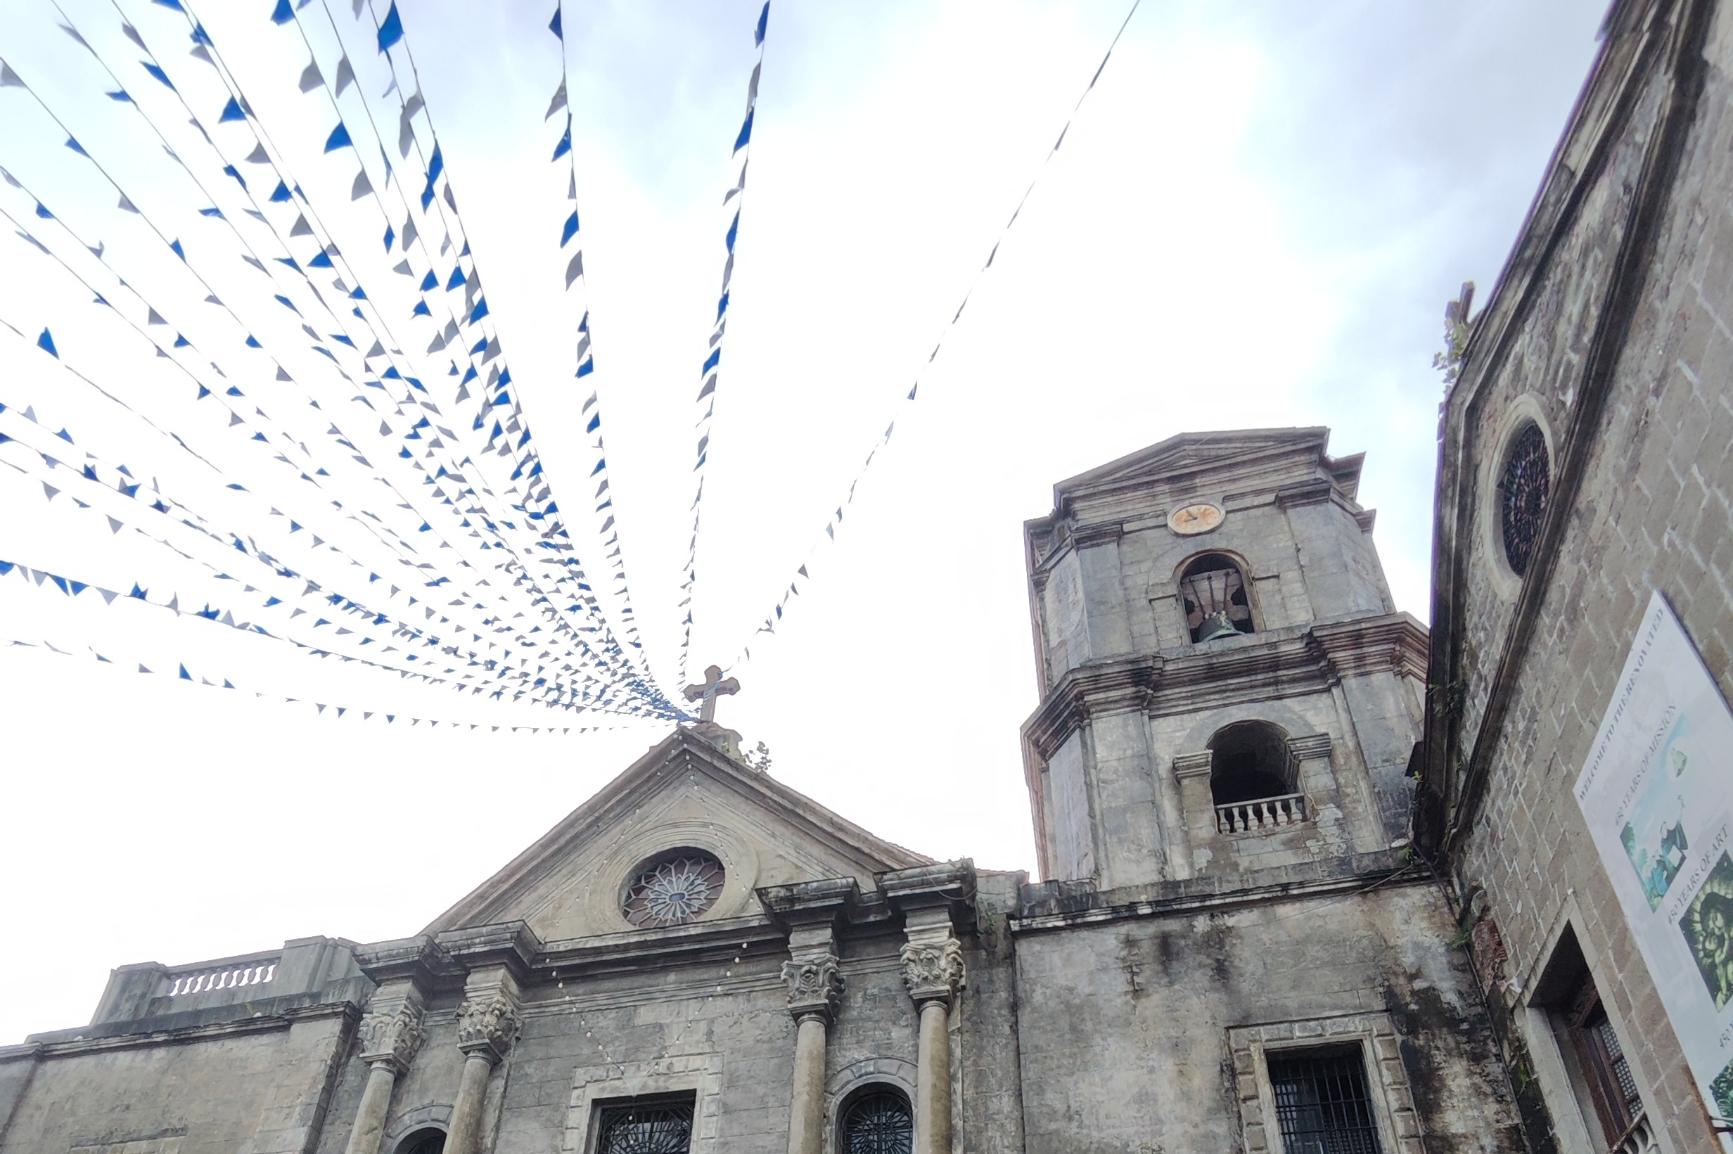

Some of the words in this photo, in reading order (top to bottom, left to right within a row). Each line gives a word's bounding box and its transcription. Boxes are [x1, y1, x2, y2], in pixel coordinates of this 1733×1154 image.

[1579, 741, 1607, 801] WELCOME
[1606, 724, 1615, 742] TO
[1614, 695, 1628, 723] THE
[1625, 608, 1664, 696] RENOVATED
[1622, 770, 1641, 809] YEARS
[1639, 752, 1651, 774] OF
[1648, 702, 1676, 757] MISSION
[1668, 904, 1679, 925] 450
[1677, 868, 1700, 907] YEARS
[1700, 849, 1711, 873] OF
[1711, 823, 1729, 857] ART
